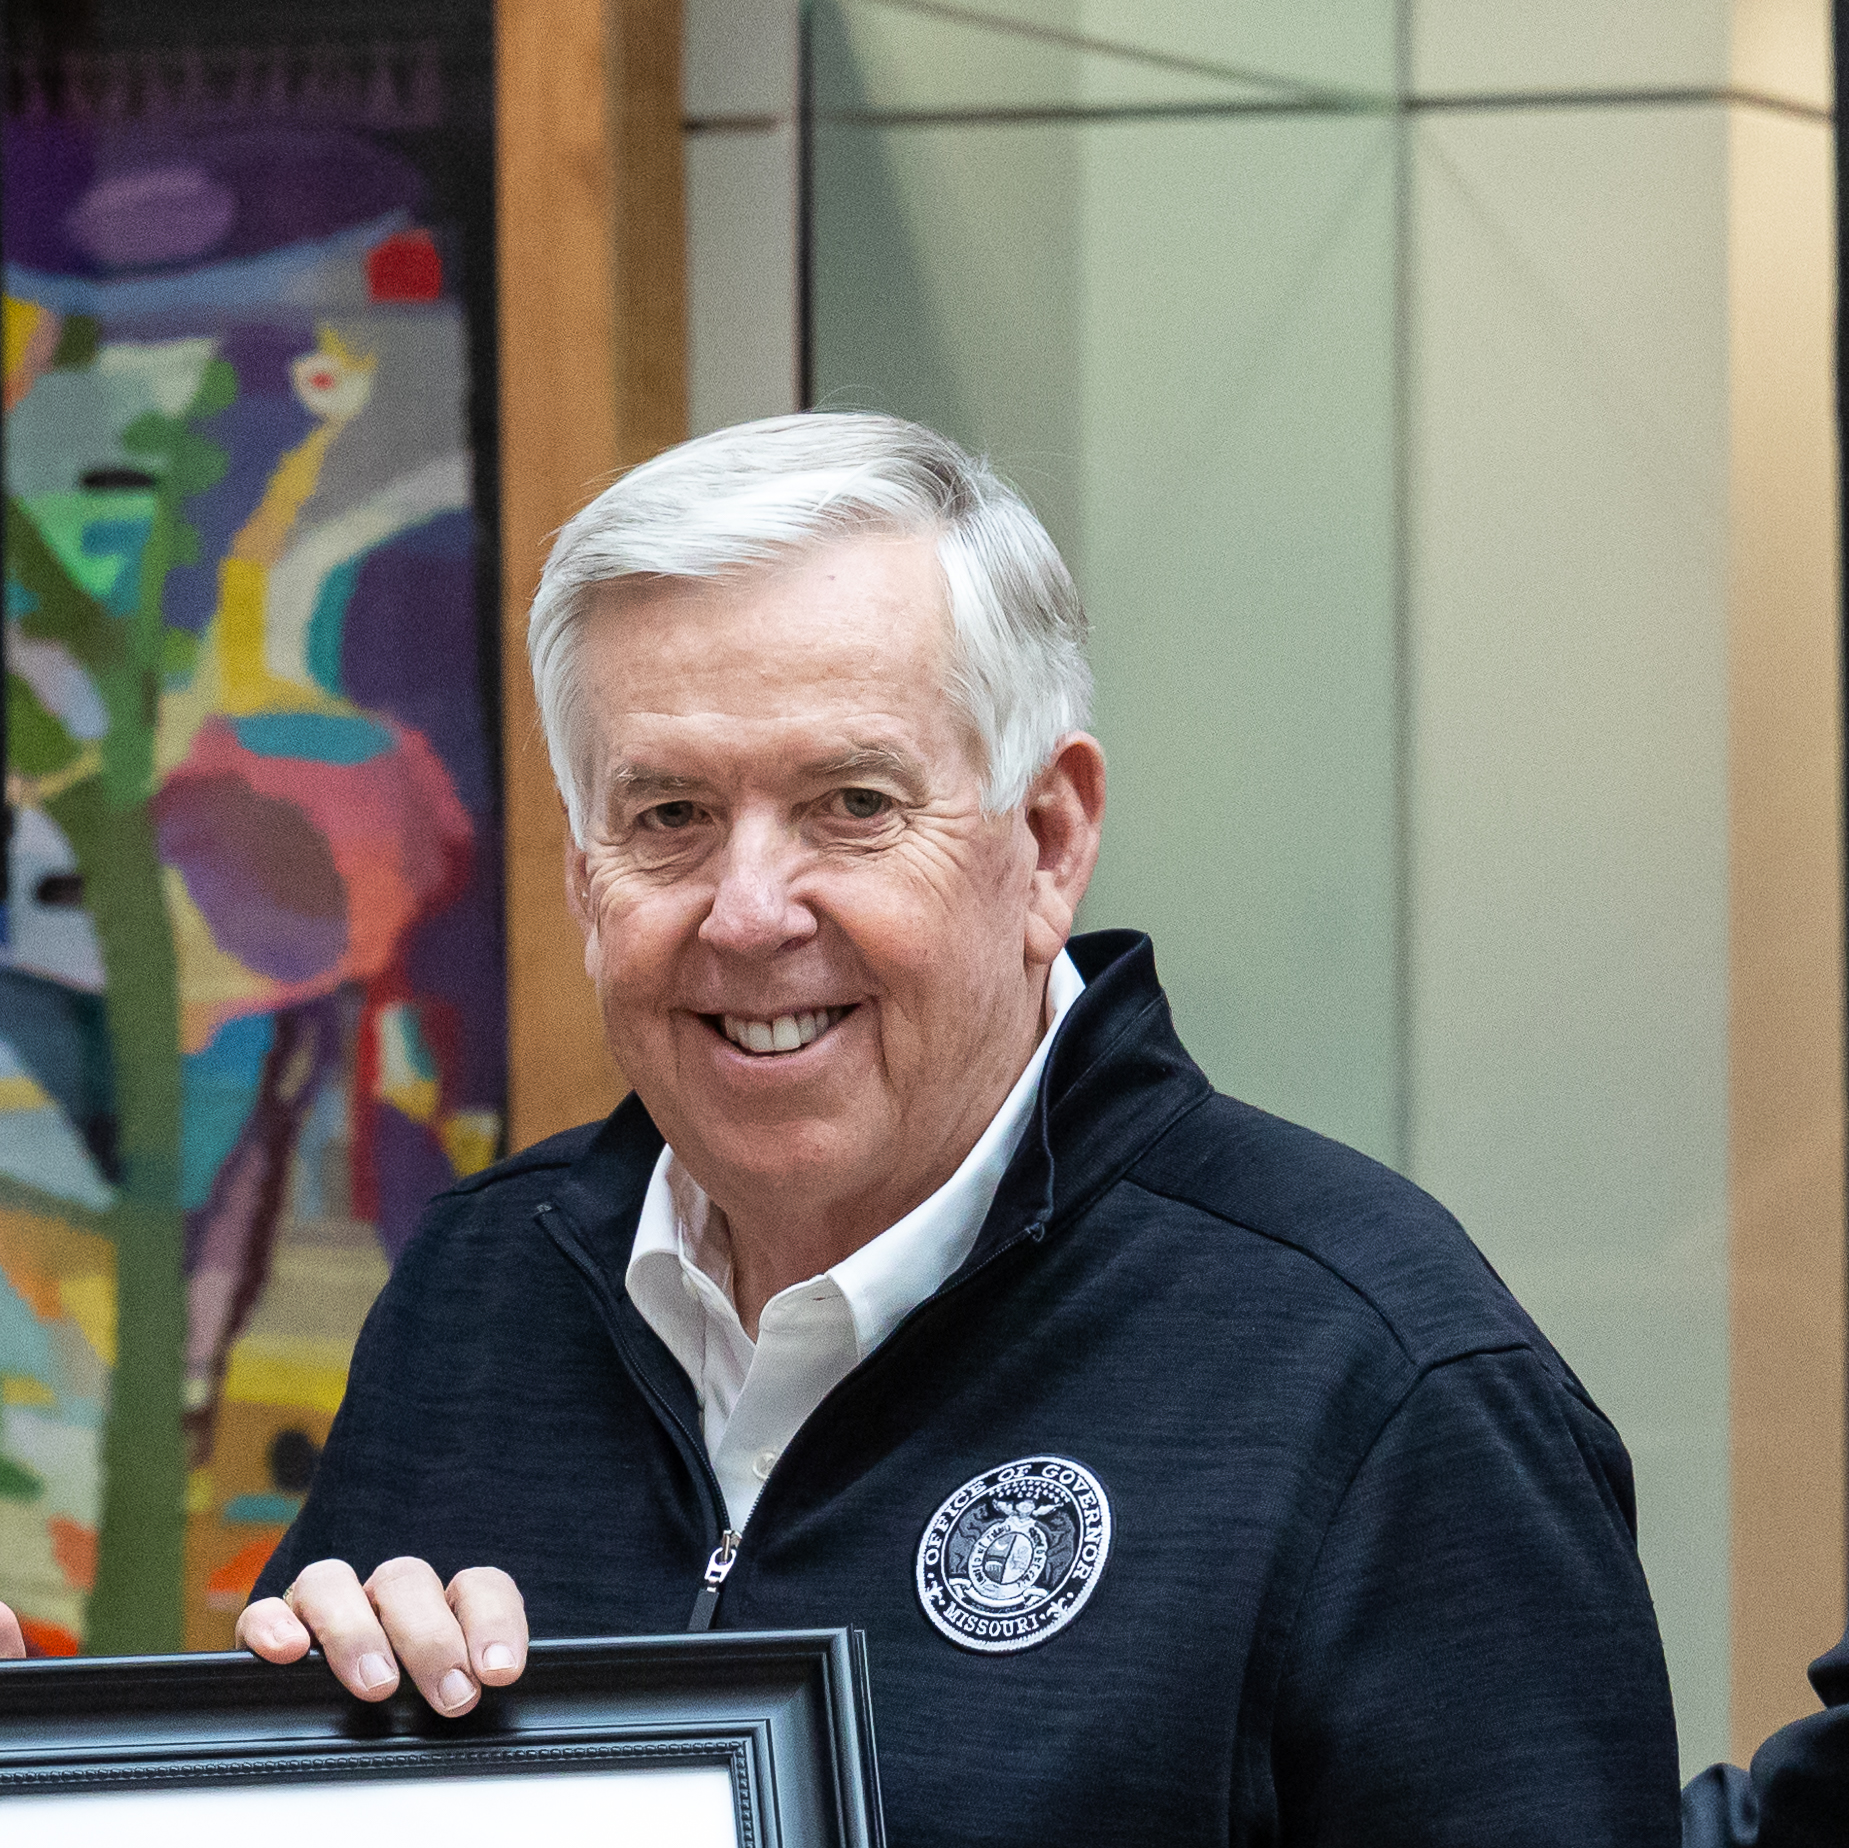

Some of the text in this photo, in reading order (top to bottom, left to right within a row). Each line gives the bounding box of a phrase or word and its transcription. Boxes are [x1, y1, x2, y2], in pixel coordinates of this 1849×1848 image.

[925, 1480, 987, 1566] OFFICE
[997, 1464, 1033, 1482] OF
[1041, 1464, 1104, 1580] GOVERNOR
[942, 1600, 1040, 1637] MISSOURI
